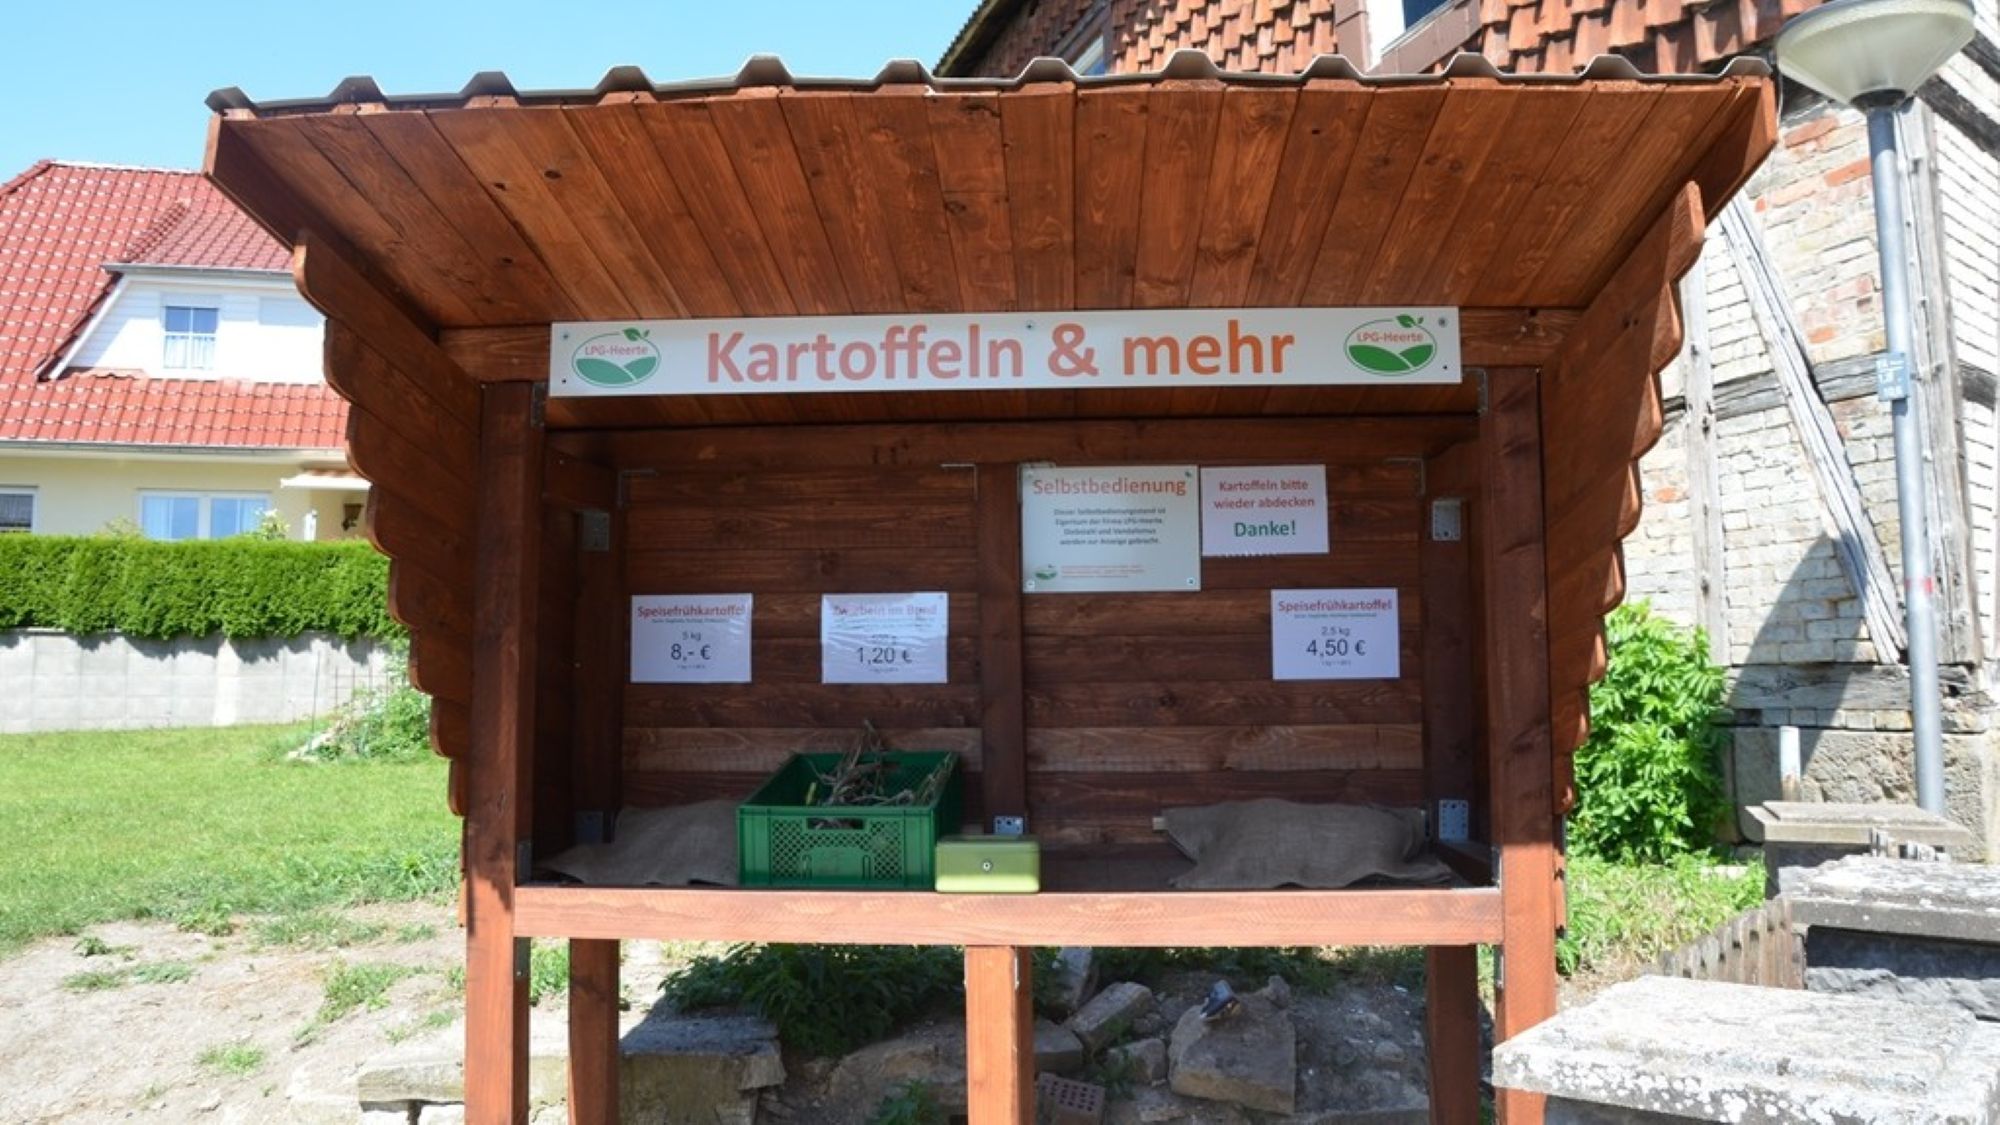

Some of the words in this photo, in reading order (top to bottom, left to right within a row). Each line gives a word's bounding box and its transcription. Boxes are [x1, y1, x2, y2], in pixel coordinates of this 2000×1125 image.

[1357, 331, 1424, 343] LPG-Heerte
[584, 344, 649, 357] LPG-Heerte
[707, 324, 1023, 383] Kartoffeln
[1048, 323, 1098, 377] &
[1123, 319, 1295, 376] mehr
[1033, 477, 1187, 496] Selbstbedienung
[1219, 480, 1278, 491] Kartoffeln
[1281, 480, 1308, 490] bitte
[1214, 499, 1255, 509] wieder
[1258, 497, 1315, 508] abdecken
[1234, 520, 1296, 537] Danke!
[1278, 598, 1393, 612] Speisefrühkartoffel
[690, 631, 702, 642] kg
[1339, 626, 1351, 637] kg
[671, 643, 695, 661] 8,-
[701, 644, 712, 660] €
[857, 647, 895, 664] 1,20
[1306, 639, 1348, 658] 4,50
[1355, 639, 1367, 656] €
